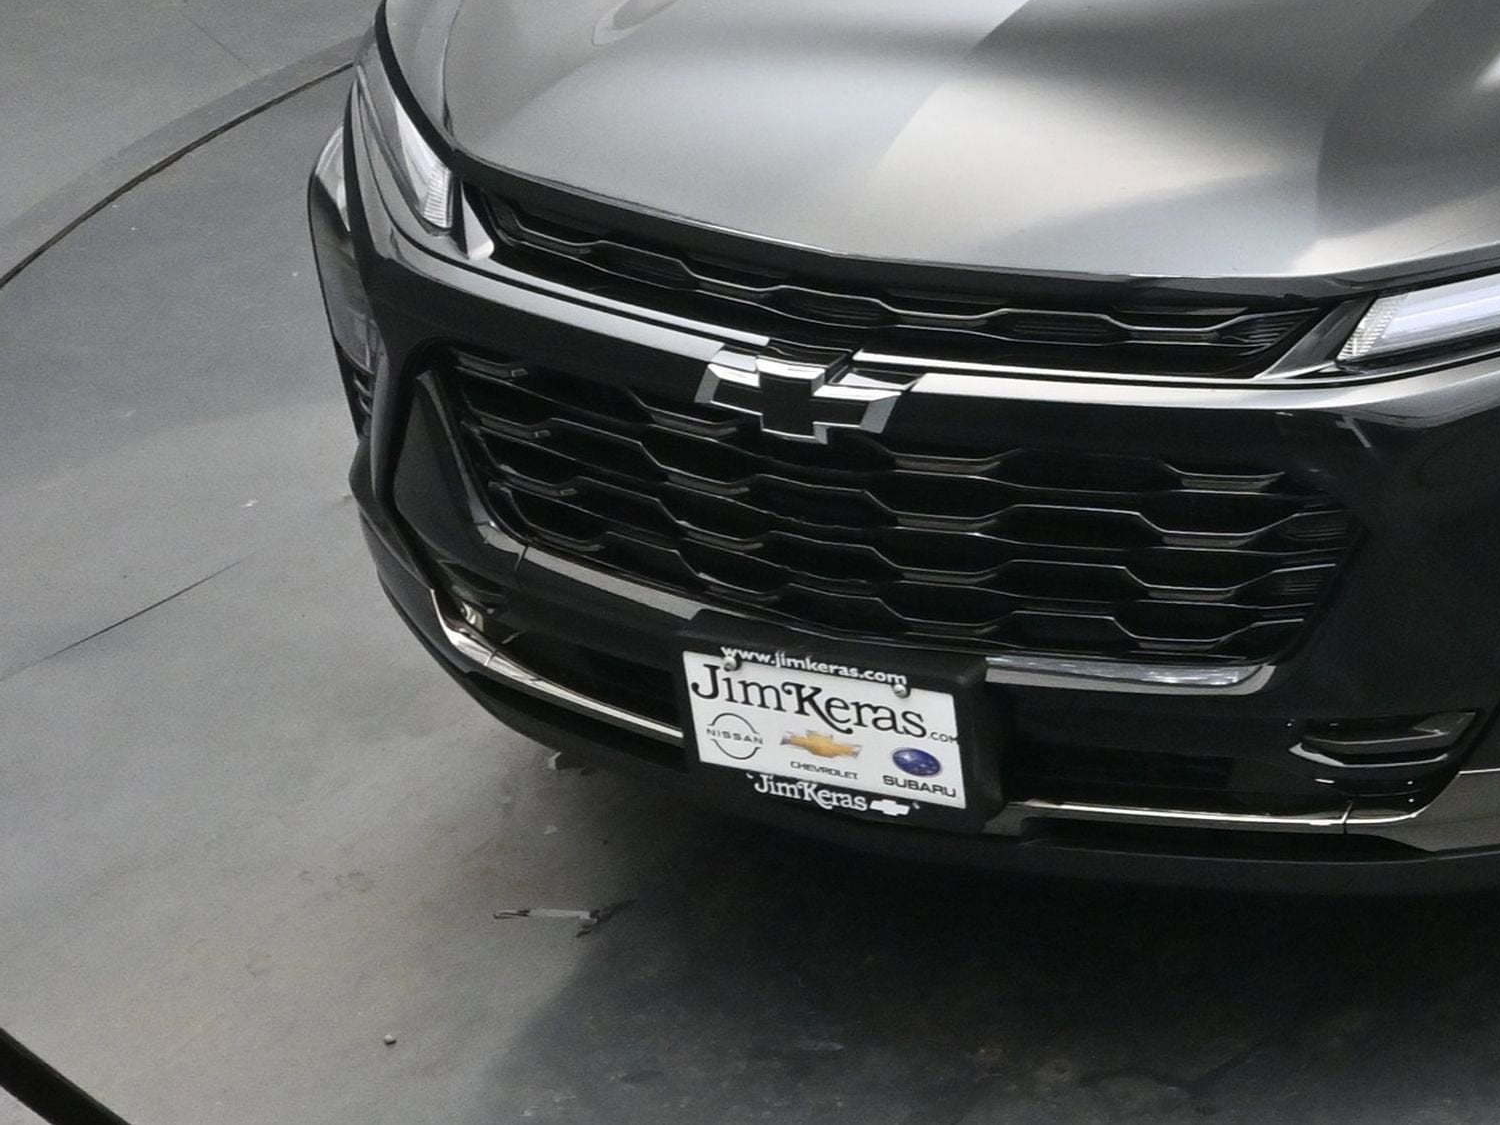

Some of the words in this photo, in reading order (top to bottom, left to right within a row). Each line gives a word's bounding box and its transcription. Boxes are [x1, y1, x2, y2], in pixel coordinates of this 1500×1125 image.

[720, 646, 908, 686] www.jimkeras.com
[706, 728, 763, 745] NISSAN
[790, 760, 858, 780] CHEVROLET
[882, 775, 956, 798] SUBARU
